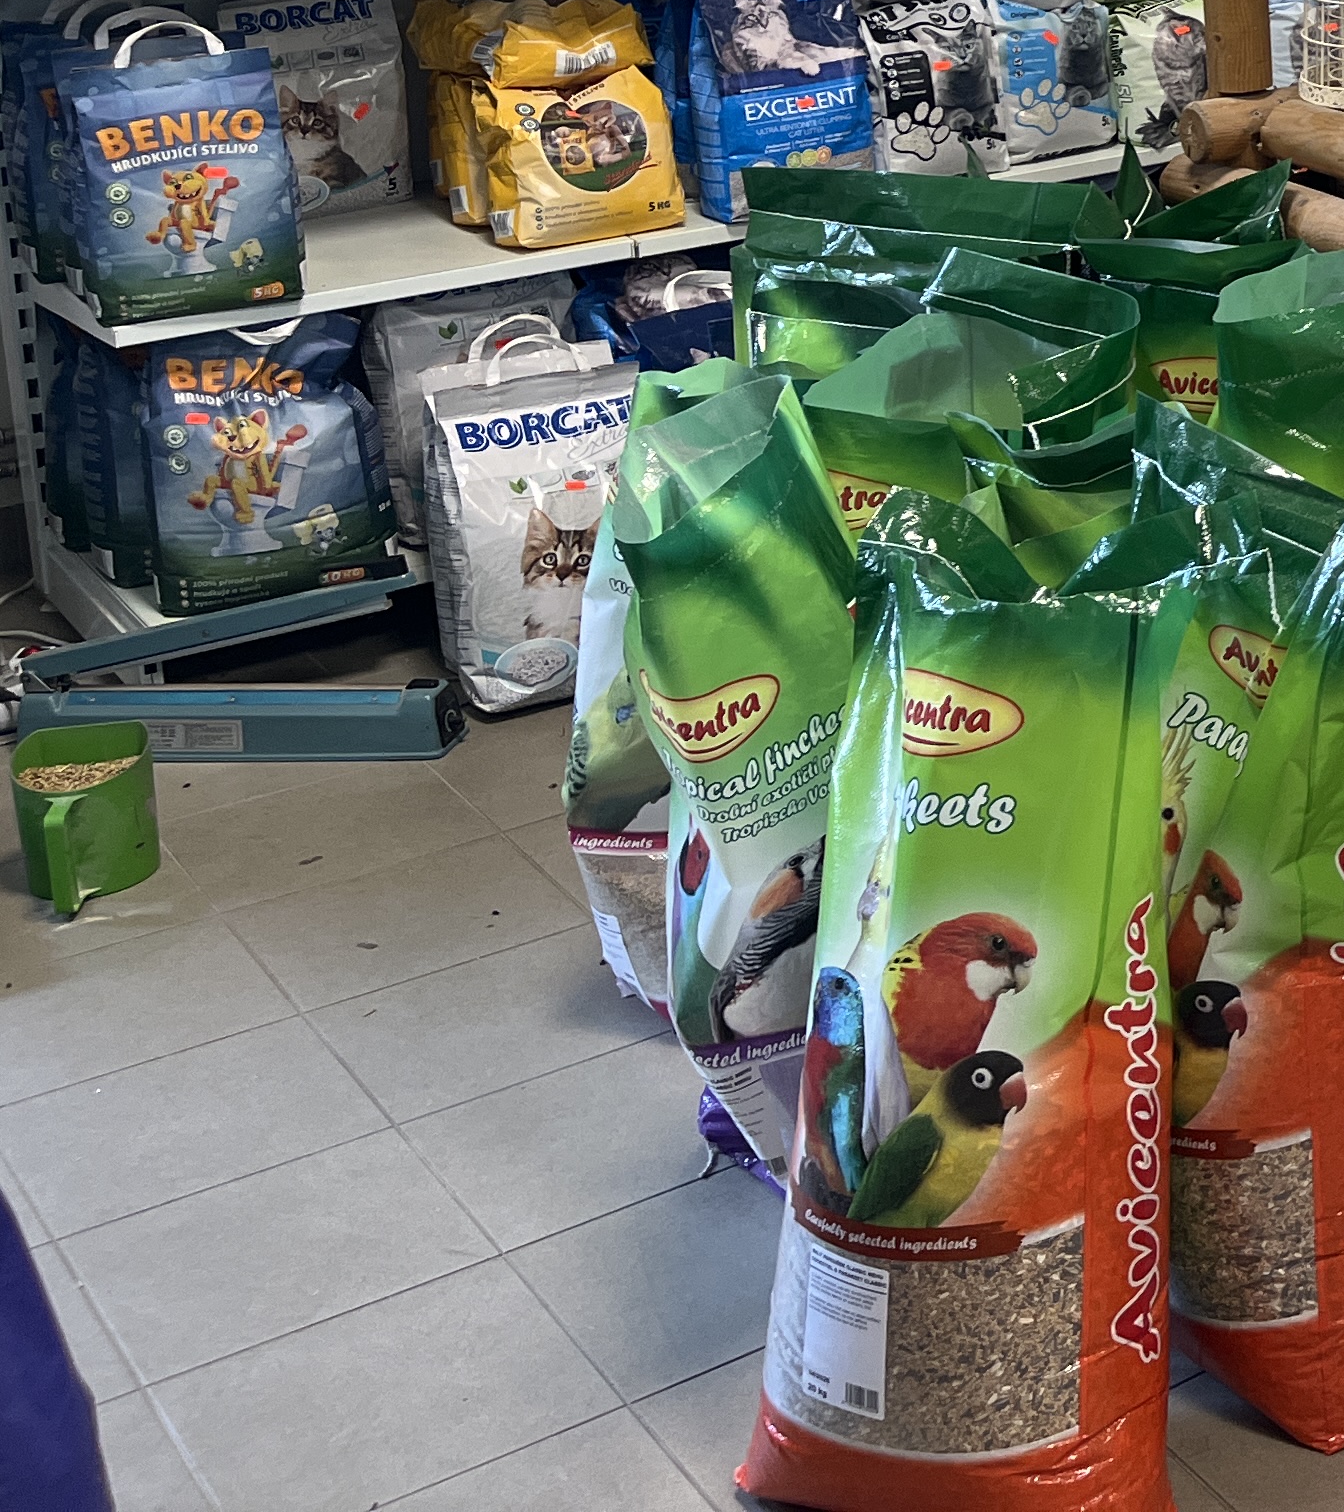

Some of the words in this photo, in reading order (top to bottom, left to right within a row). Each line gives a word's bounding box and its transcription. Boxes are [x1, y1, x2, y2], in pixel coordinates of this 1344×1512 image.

[96, 108, 265, 161] BENKO
[111, 143, 198, 174] HRUDKUJÍCÍ
[200, 141, 259, 157] STELIVO
[648, 200, 656, 212] 5
[657, 199, 671, 211] KG
[254, 288, 262, 299] 5
[263, 285, 279, 297] KG
[721, 795, 808, 844] Tropische
[572, 833, 654, 850] ingredients
[1103, 892, 1164, 1364] Avicentra
[805, 1208, 847, 1241] Carefully
[847, 1229, 896, 1250] selected
[899, 1236, 978, 1254] ingredients
